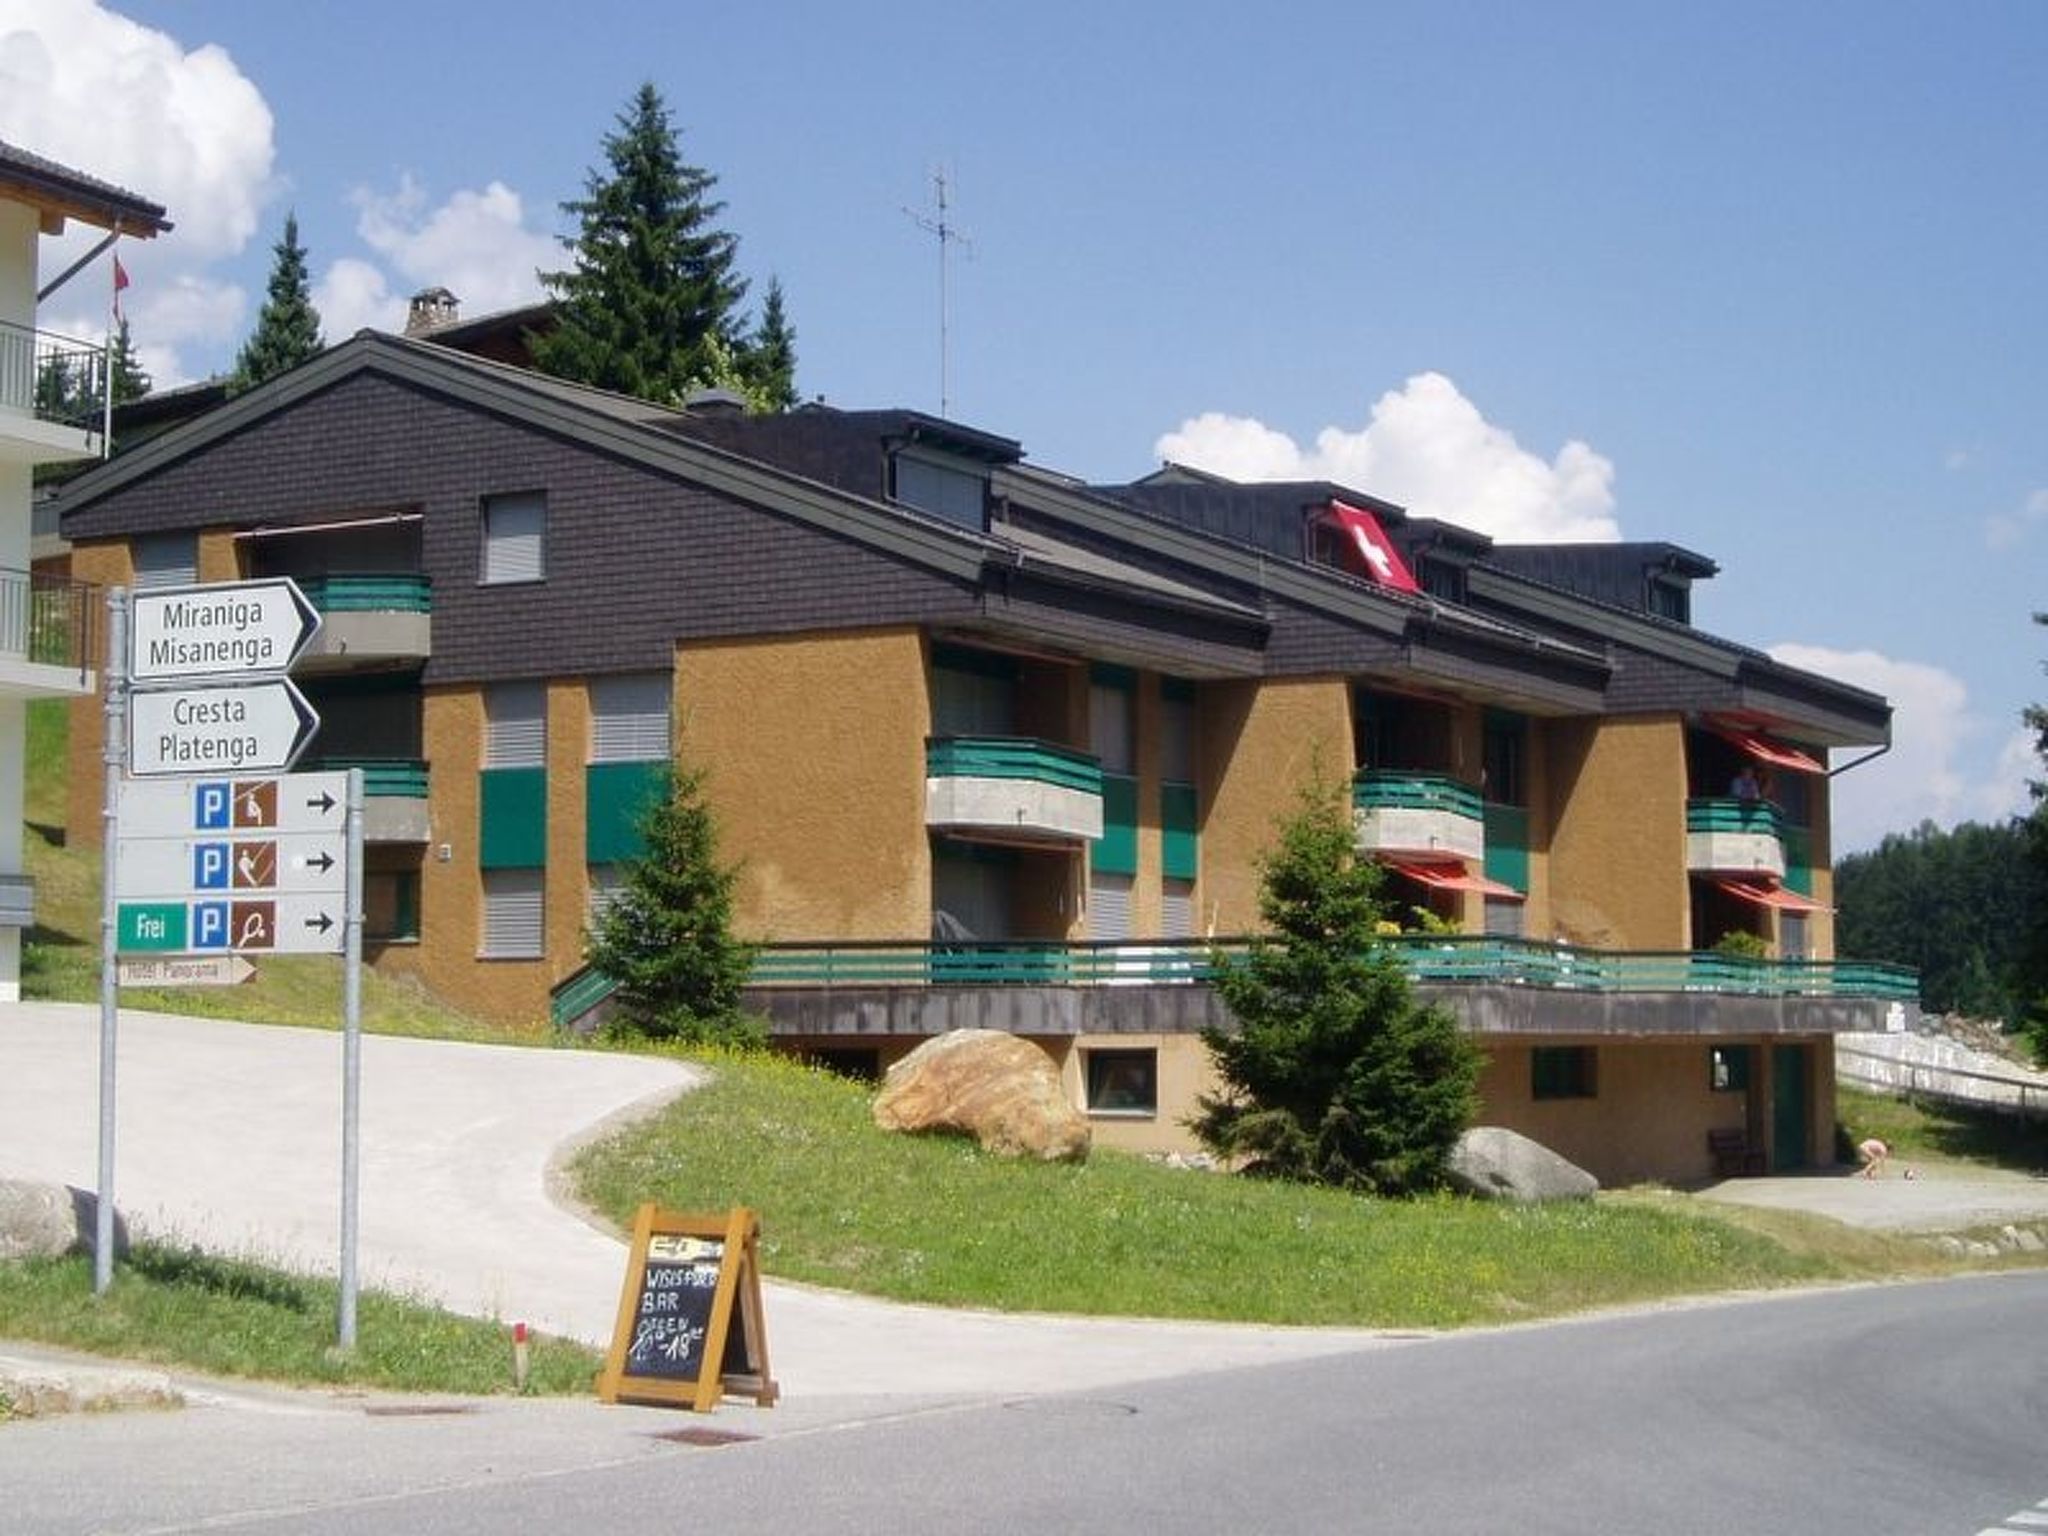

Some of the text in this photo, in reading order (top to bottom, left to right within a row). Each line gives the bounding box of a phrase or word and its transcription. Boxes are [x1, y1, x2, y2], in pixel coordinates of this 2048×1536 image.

[163, 599, 263, 630] Miraniga
[150, 637, 273, 666] Misanenga
[173, 698, 246, 726] Cresta
[160, 734, 258, 765] Platenga
[204, 790, 222, 824] P
[203, 849, 221, 884] P
[137, 908, 220, 943] Frei P
[642, 1292, 679, 1313] BAR
